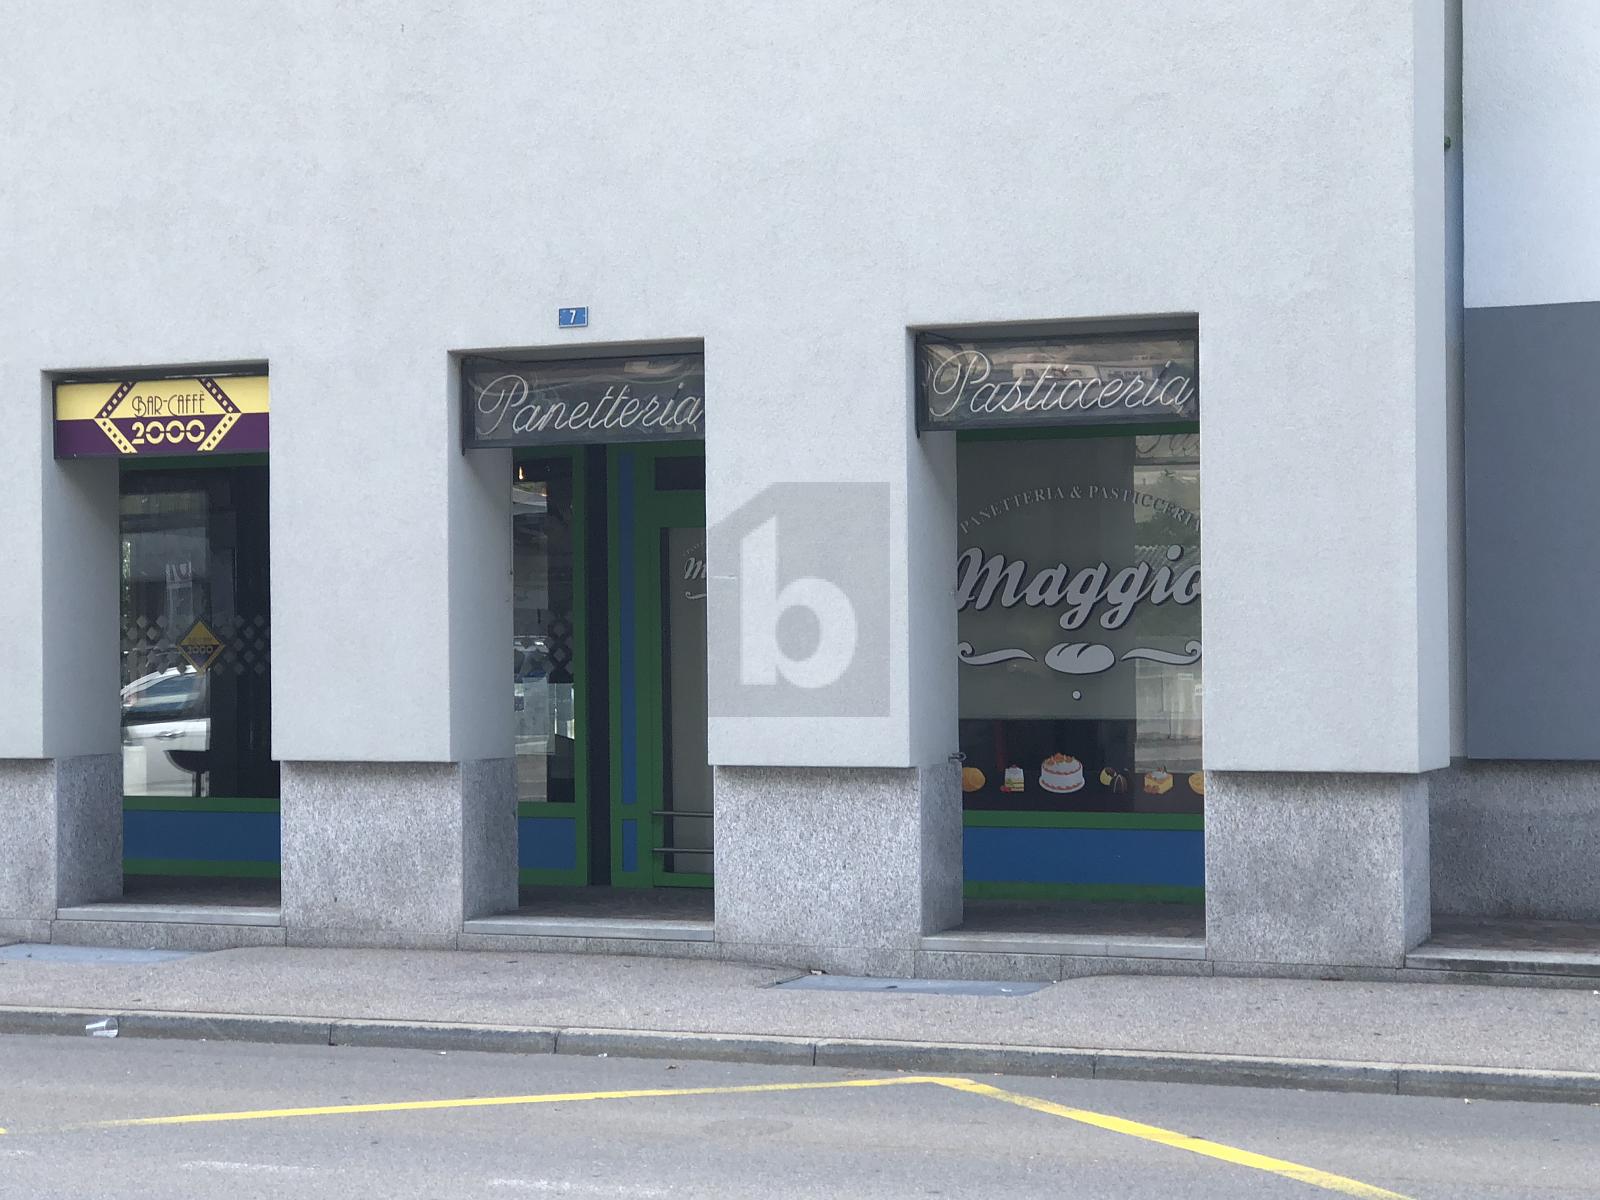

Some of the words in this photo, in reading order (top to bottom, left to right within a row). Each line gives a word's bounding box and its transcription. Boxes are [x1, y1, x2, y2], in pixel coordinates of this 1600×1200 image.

[569, 309, 577, 324] 7
[477, 374, 704, 436] Panetteria
[929, 350, 1195, 417] Pasticceria
[131, 419, 206, 445] 2000
[960, 487, 1065, 534] PANETTERIA
[1070, 485, 1082, 499] &
